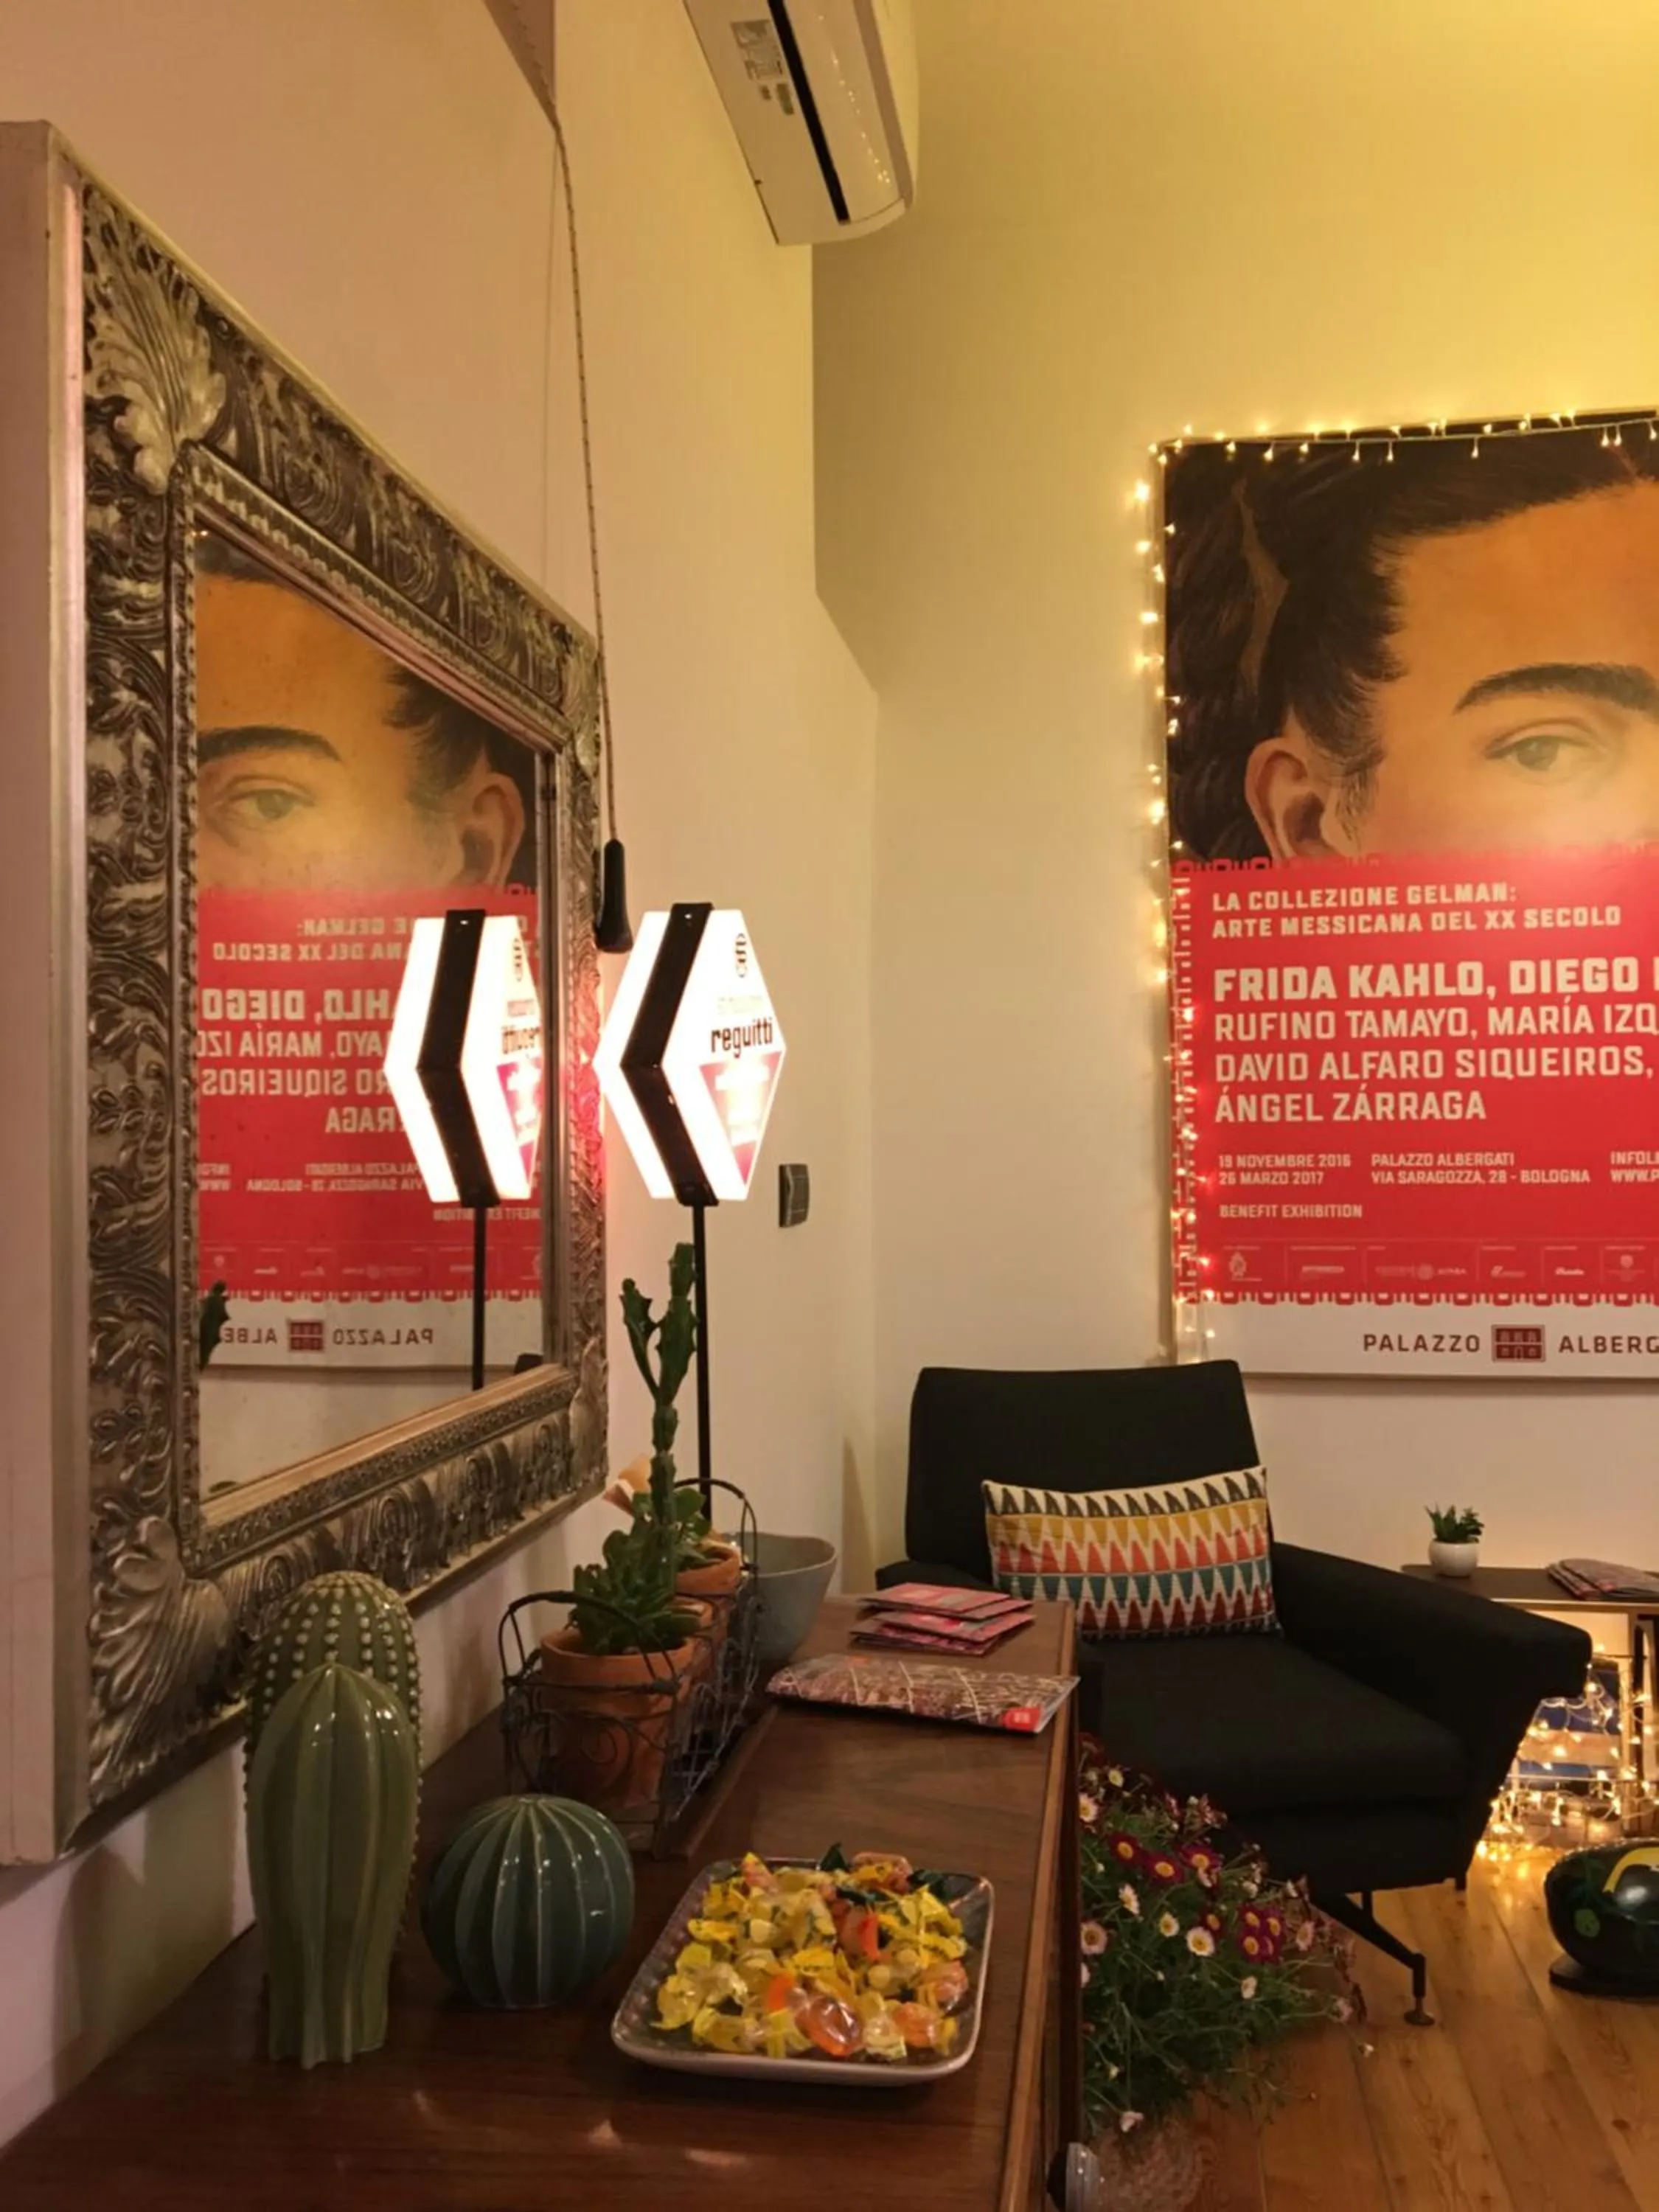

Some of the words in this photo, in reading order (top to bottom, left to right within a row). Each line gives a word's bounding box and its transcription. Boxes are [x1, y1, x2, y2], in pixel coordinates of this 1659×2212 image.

[1212, 892, 1240, 911] LA
[1248, 887, 1399, 911] COLLEZIONE
[1407, 882, 1516, 905] GELMAN:
[1212, 918, 1272, 939] ARTE
[1281, 913, 1423, 936] MESSICANA
[1431, 911, 1477, 931] DEL
[1484, 909, 1516, 930] XX
[1524, 905, 1621, 928] SECOLO
[1214, 966, 1338, 1002] FRIDA
[1349, 961, 1496, 1001] KAHLO,
[1510, 956, 1638, 994] DIEGO
[1215, 1010, 1336, 1041] RUFINO
[1345, 1007, 1478, 1040] TAMAYO,
[1488, 995, 1594, 1035] MARÍA
[711, 1017, 773, 1059] reguitti
[1216, 1052, 1309, 1082] DAVID
[1319, 1049, 1444, 1080] ALFARO
[1455, 1046, 1653, 1079] SIQUEIROS,
[1215, 1085, 1324, 1122] ÁNGEL
[1333, 1083, 1486, 1121] ZÁRRAGA
[1237, 1154, 1315, 1168] NOVEMBRE
[1318, 1153, 1351, 1167] 2016
[1371, 1153, 1433, 1166] PALAZZO
[1438, 1152, 1514, 1166] ALBERGATI
[1220, 1171, 1236, 1185] 26
[1239, 1171, 1290, 1185] MARZO
[1293, 1170, 1324, 1185] 2017
[1371, 1171, 1394, 1184] VIA
[1398, 1170, 1485, 1184] SARAGOZZA,
[1489, 1169, 1507, 1183] 28
[1520, 1169, 1590, 1183] BOLOGNA
[1220, 1204, 1278, 1218] BENEFIT
[1281, 1204, 1363, 1218] EXHIBITION
[1363, 1334, 1481, 1352] PALAZZO
[1558, 1335, 1659, 1354] ALBERG
